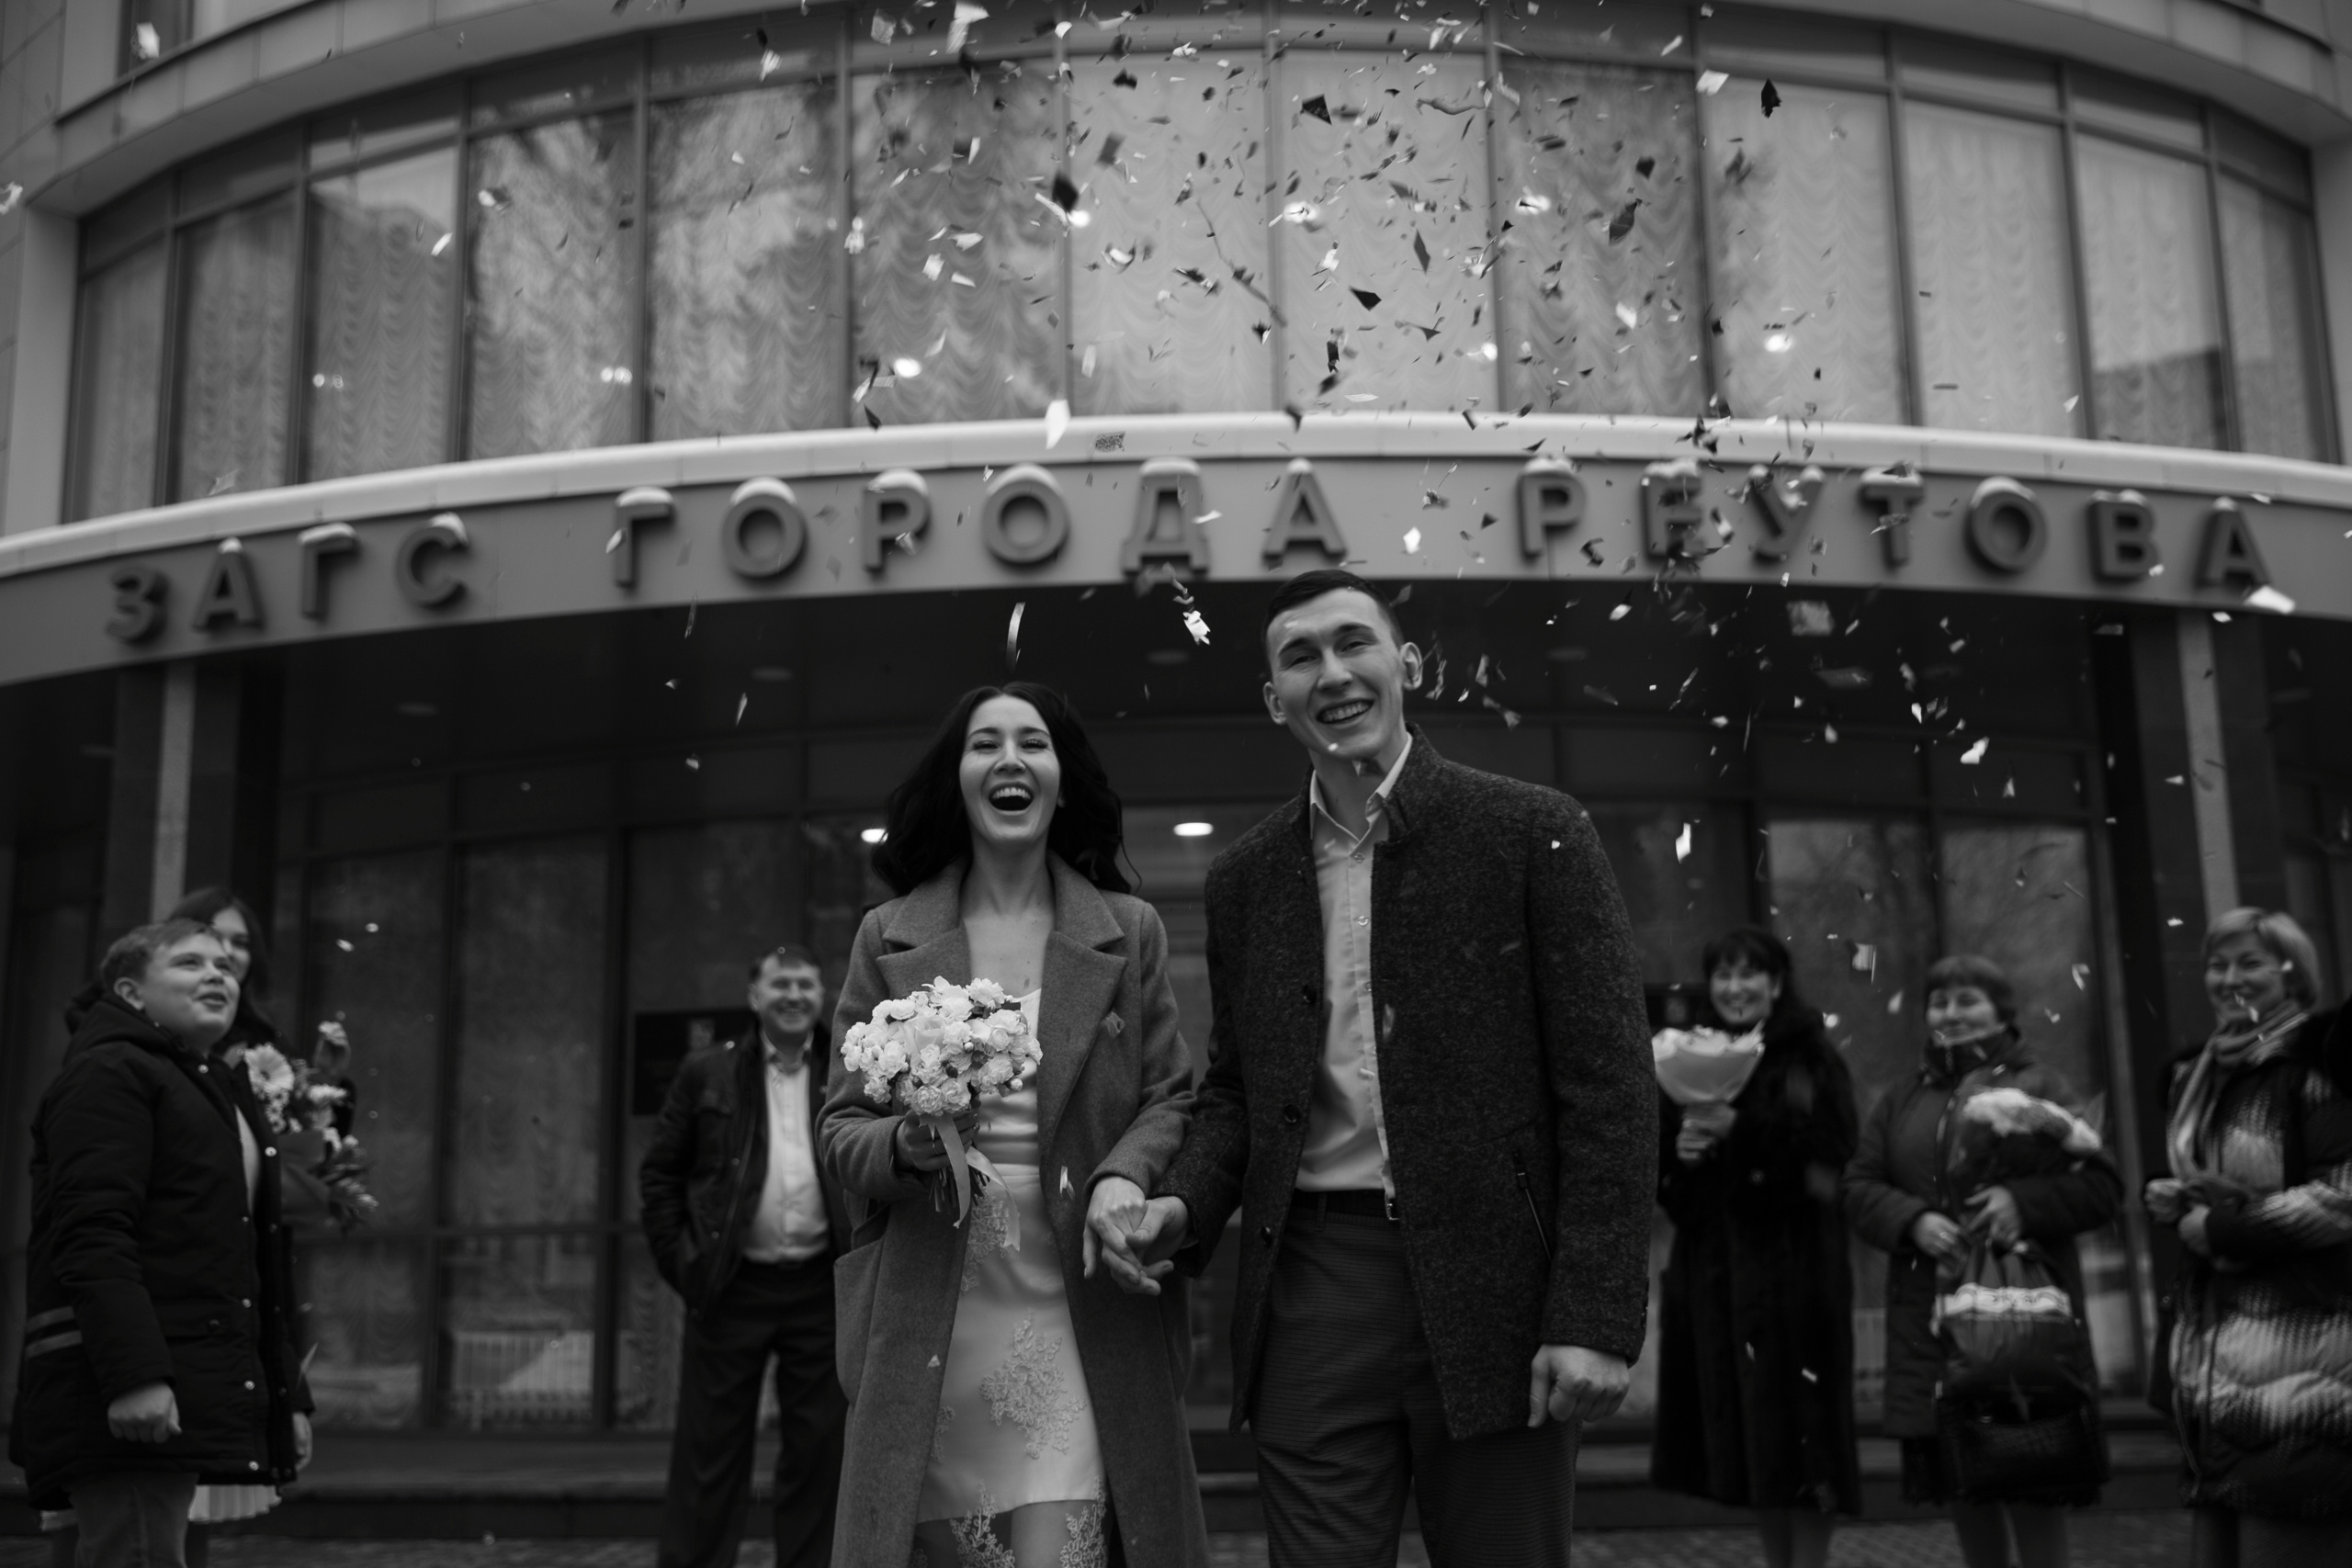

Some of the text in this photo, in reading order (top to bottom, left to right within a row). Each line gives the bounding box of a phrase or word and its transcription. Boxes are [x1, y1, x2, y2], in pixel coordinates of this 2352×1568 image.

[105, 457, 2271, 642] ЗАГС ГОРОДА РЕУТОВА
